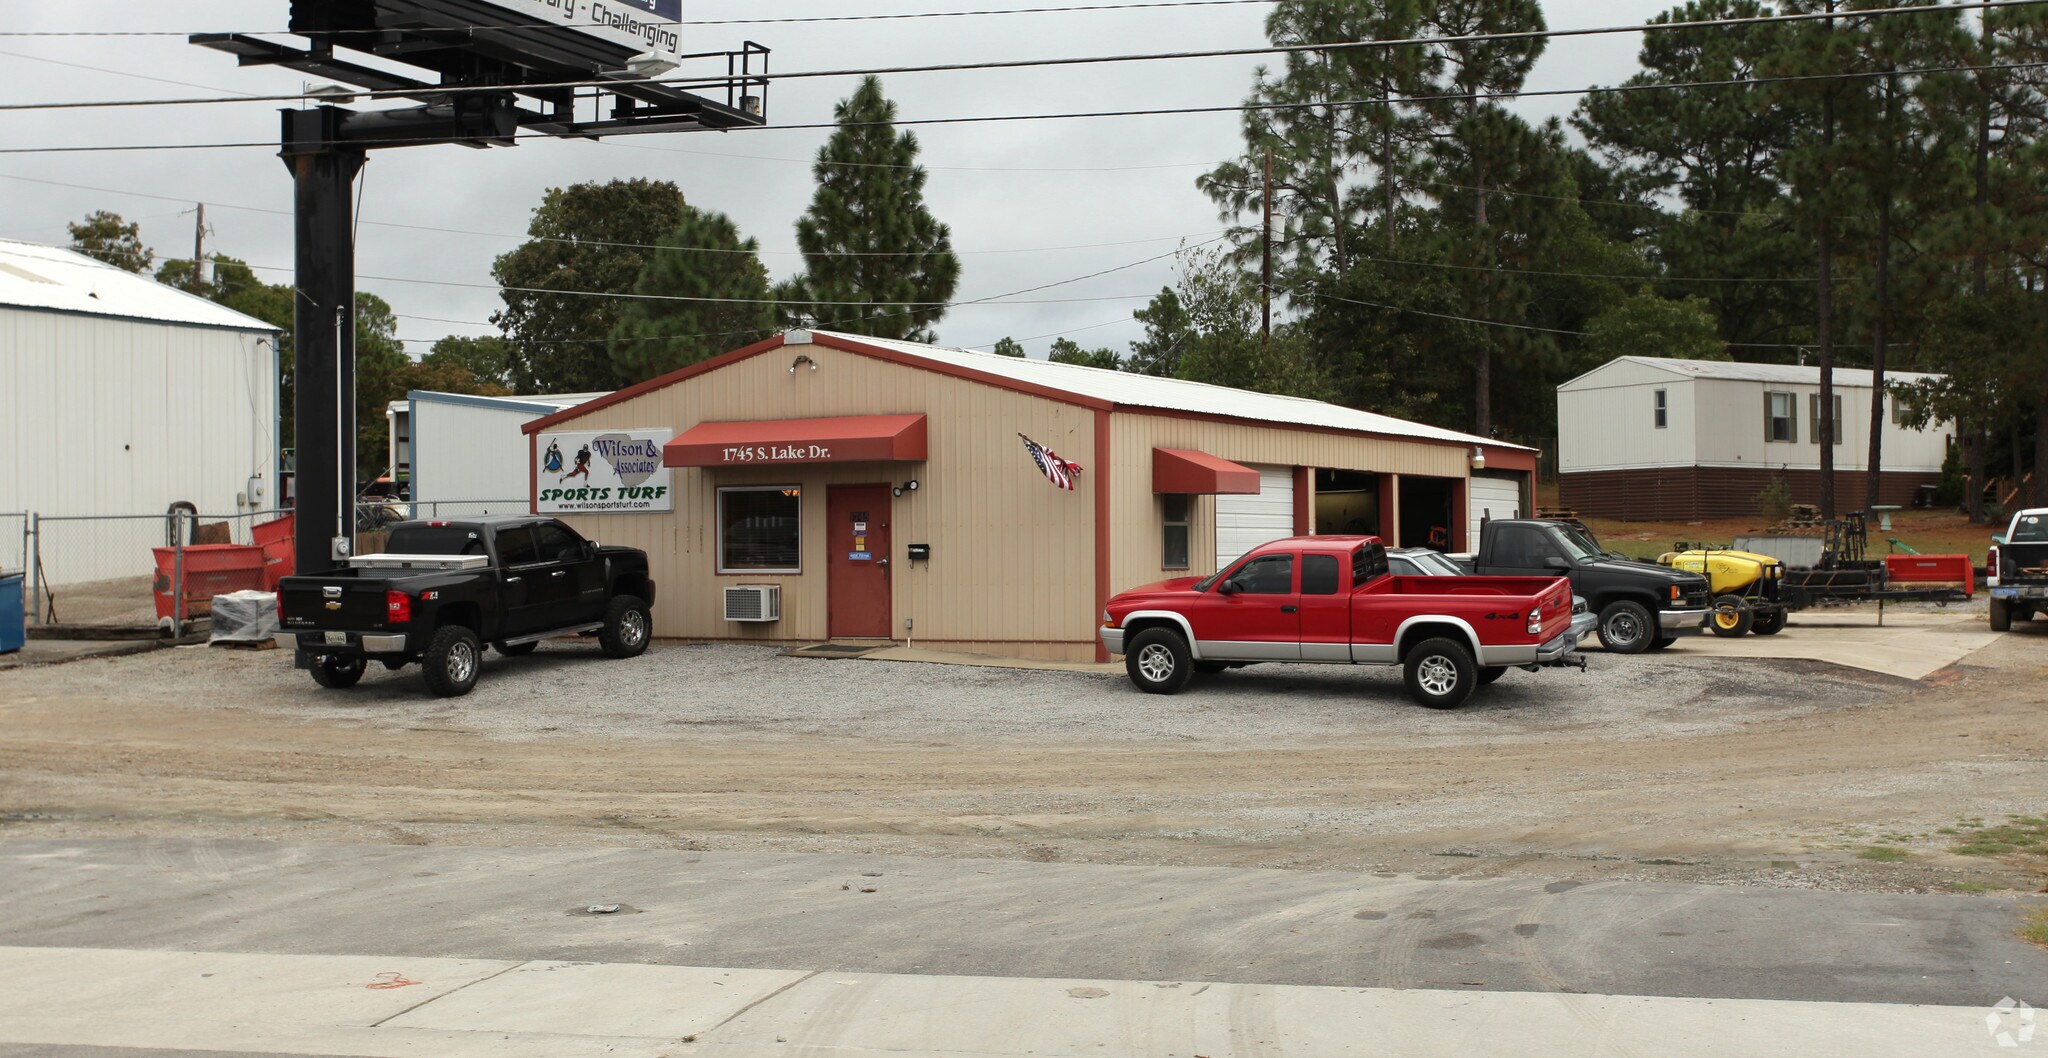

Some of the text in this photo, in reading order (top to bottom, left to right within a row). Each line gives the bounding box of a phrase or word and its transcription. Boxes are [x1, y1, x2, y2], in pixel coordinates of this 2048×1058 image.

[592, 2, 678, 53] Challenging
[592, 439, 658, 457] Wilson &
[722, 445, 831, 461] 1745 S. Lake Dr.
[613, 459, 655, 479] Associates
[540, 486, 667, 501] SPORTS TURF
[558, 501, 650, 510] www.wilsonsportsturf.com
